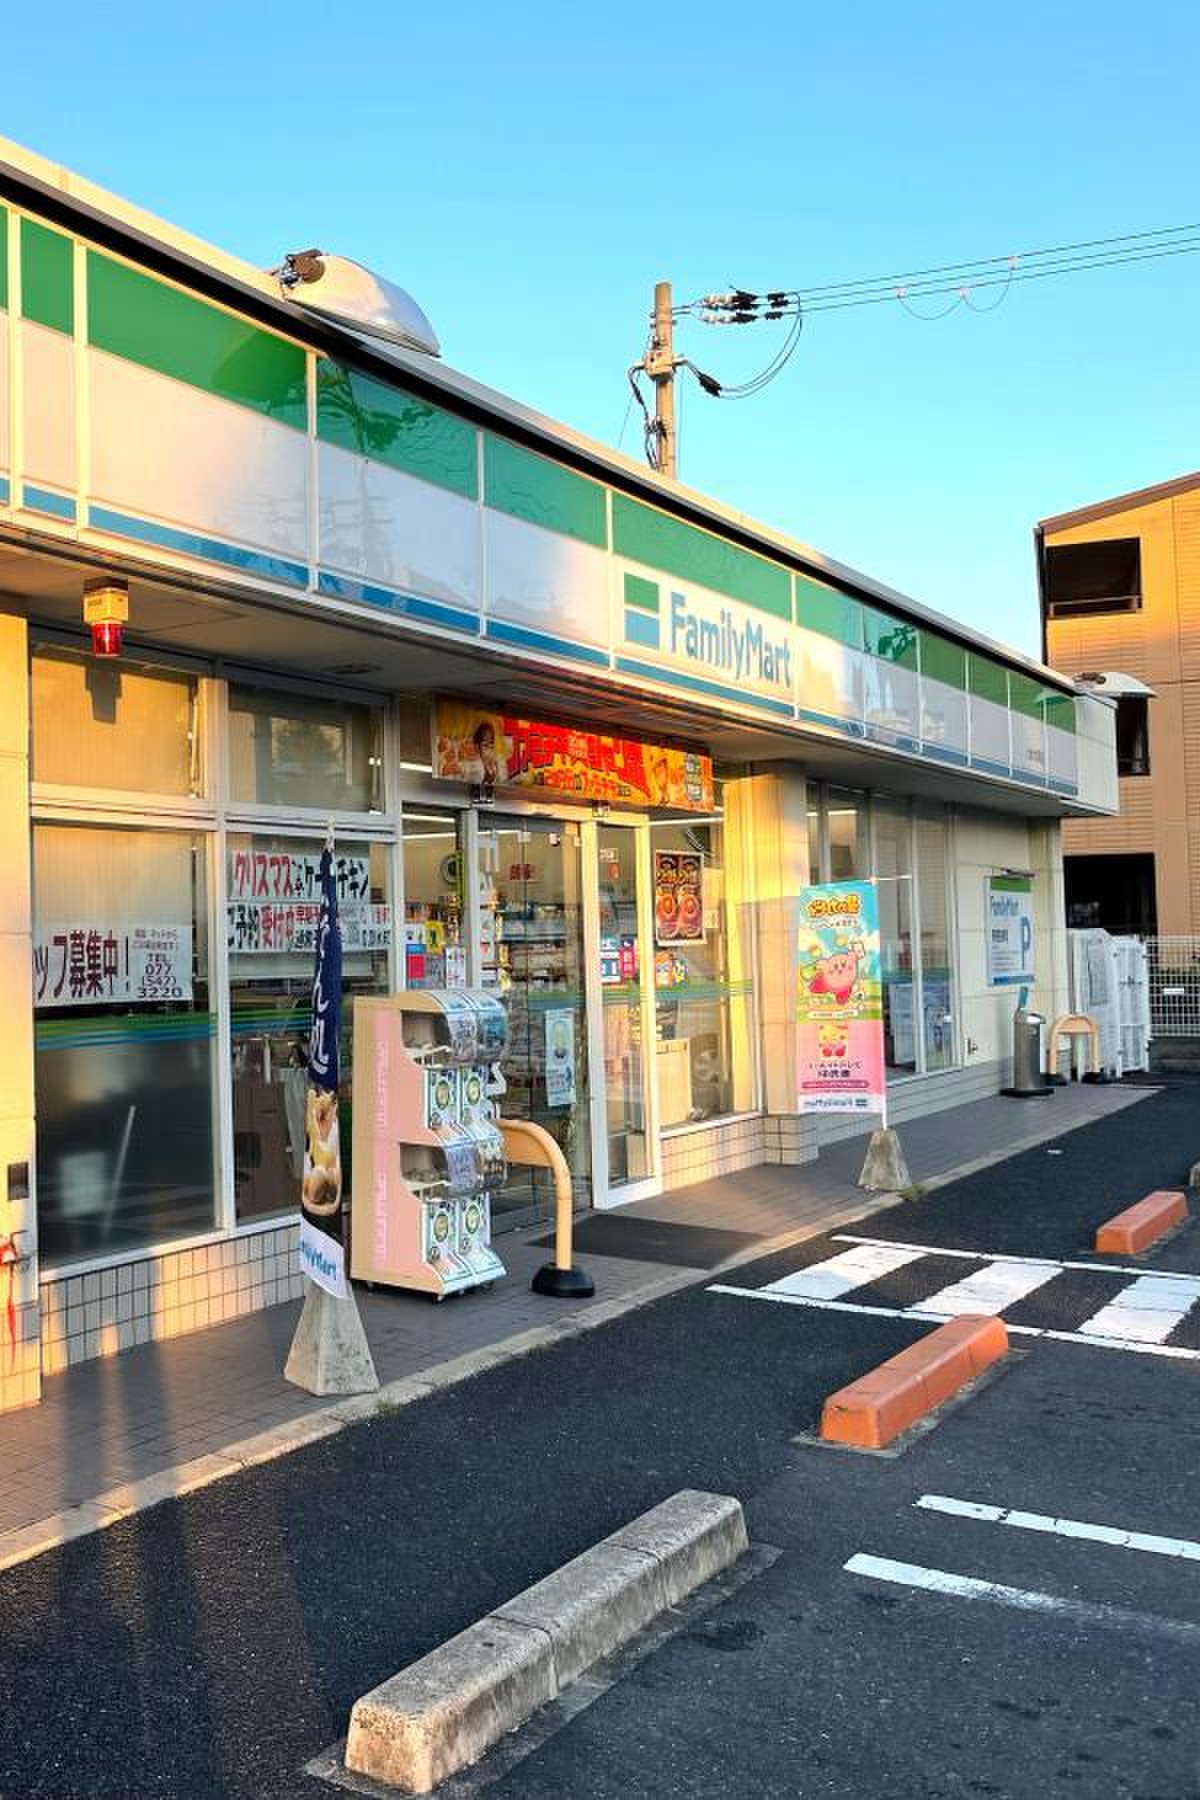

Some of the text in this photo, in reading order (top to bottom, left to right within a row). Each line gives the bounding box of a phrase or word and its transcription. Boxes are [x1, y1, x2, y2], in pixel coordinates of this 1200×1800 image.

[671, 591, 790, 689] FamilyMart
[145, 963, 172, 976] 077
[137, 986, 183, 999] 3220
